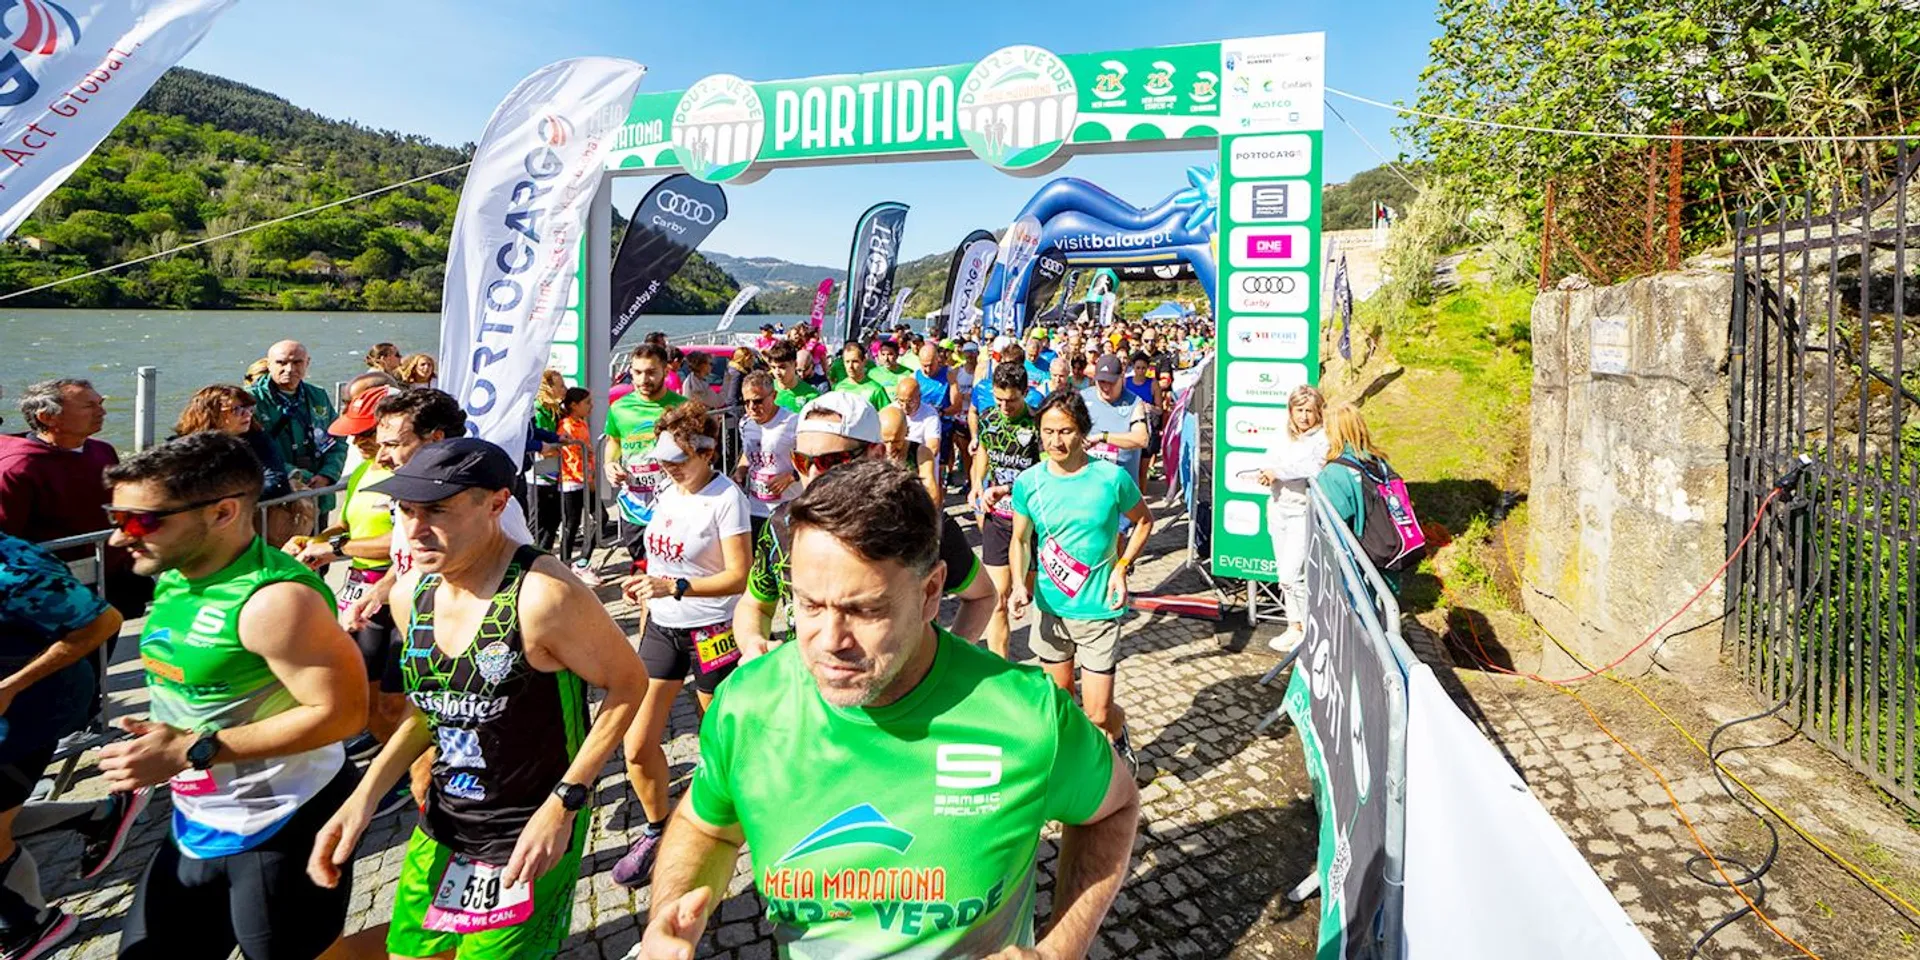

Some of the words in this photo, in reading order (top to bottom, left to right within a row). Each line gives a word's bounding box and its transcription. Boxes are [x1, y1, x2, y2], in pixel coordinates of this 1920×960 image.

[1023, 49, 1072, 92] VERDE
[774, 75, 955, 151] PARTIDA
[1, 122, 57, 167] Act
[652, 215, 686, 235] Carby
[1256, 240, 1282, 251] ONE
[611, 279, 661, 336] audi.carby.pt
[1049, 558, 1070, 582] 331
[1219, 555, 1277, 571] EVENTSP
[460, 874, 500, 910] 559
[764, 868, 814, 900] MEIA
[823, 868, 946, 901] MARATONA
[873, 877, 1005, 936] VERDE
